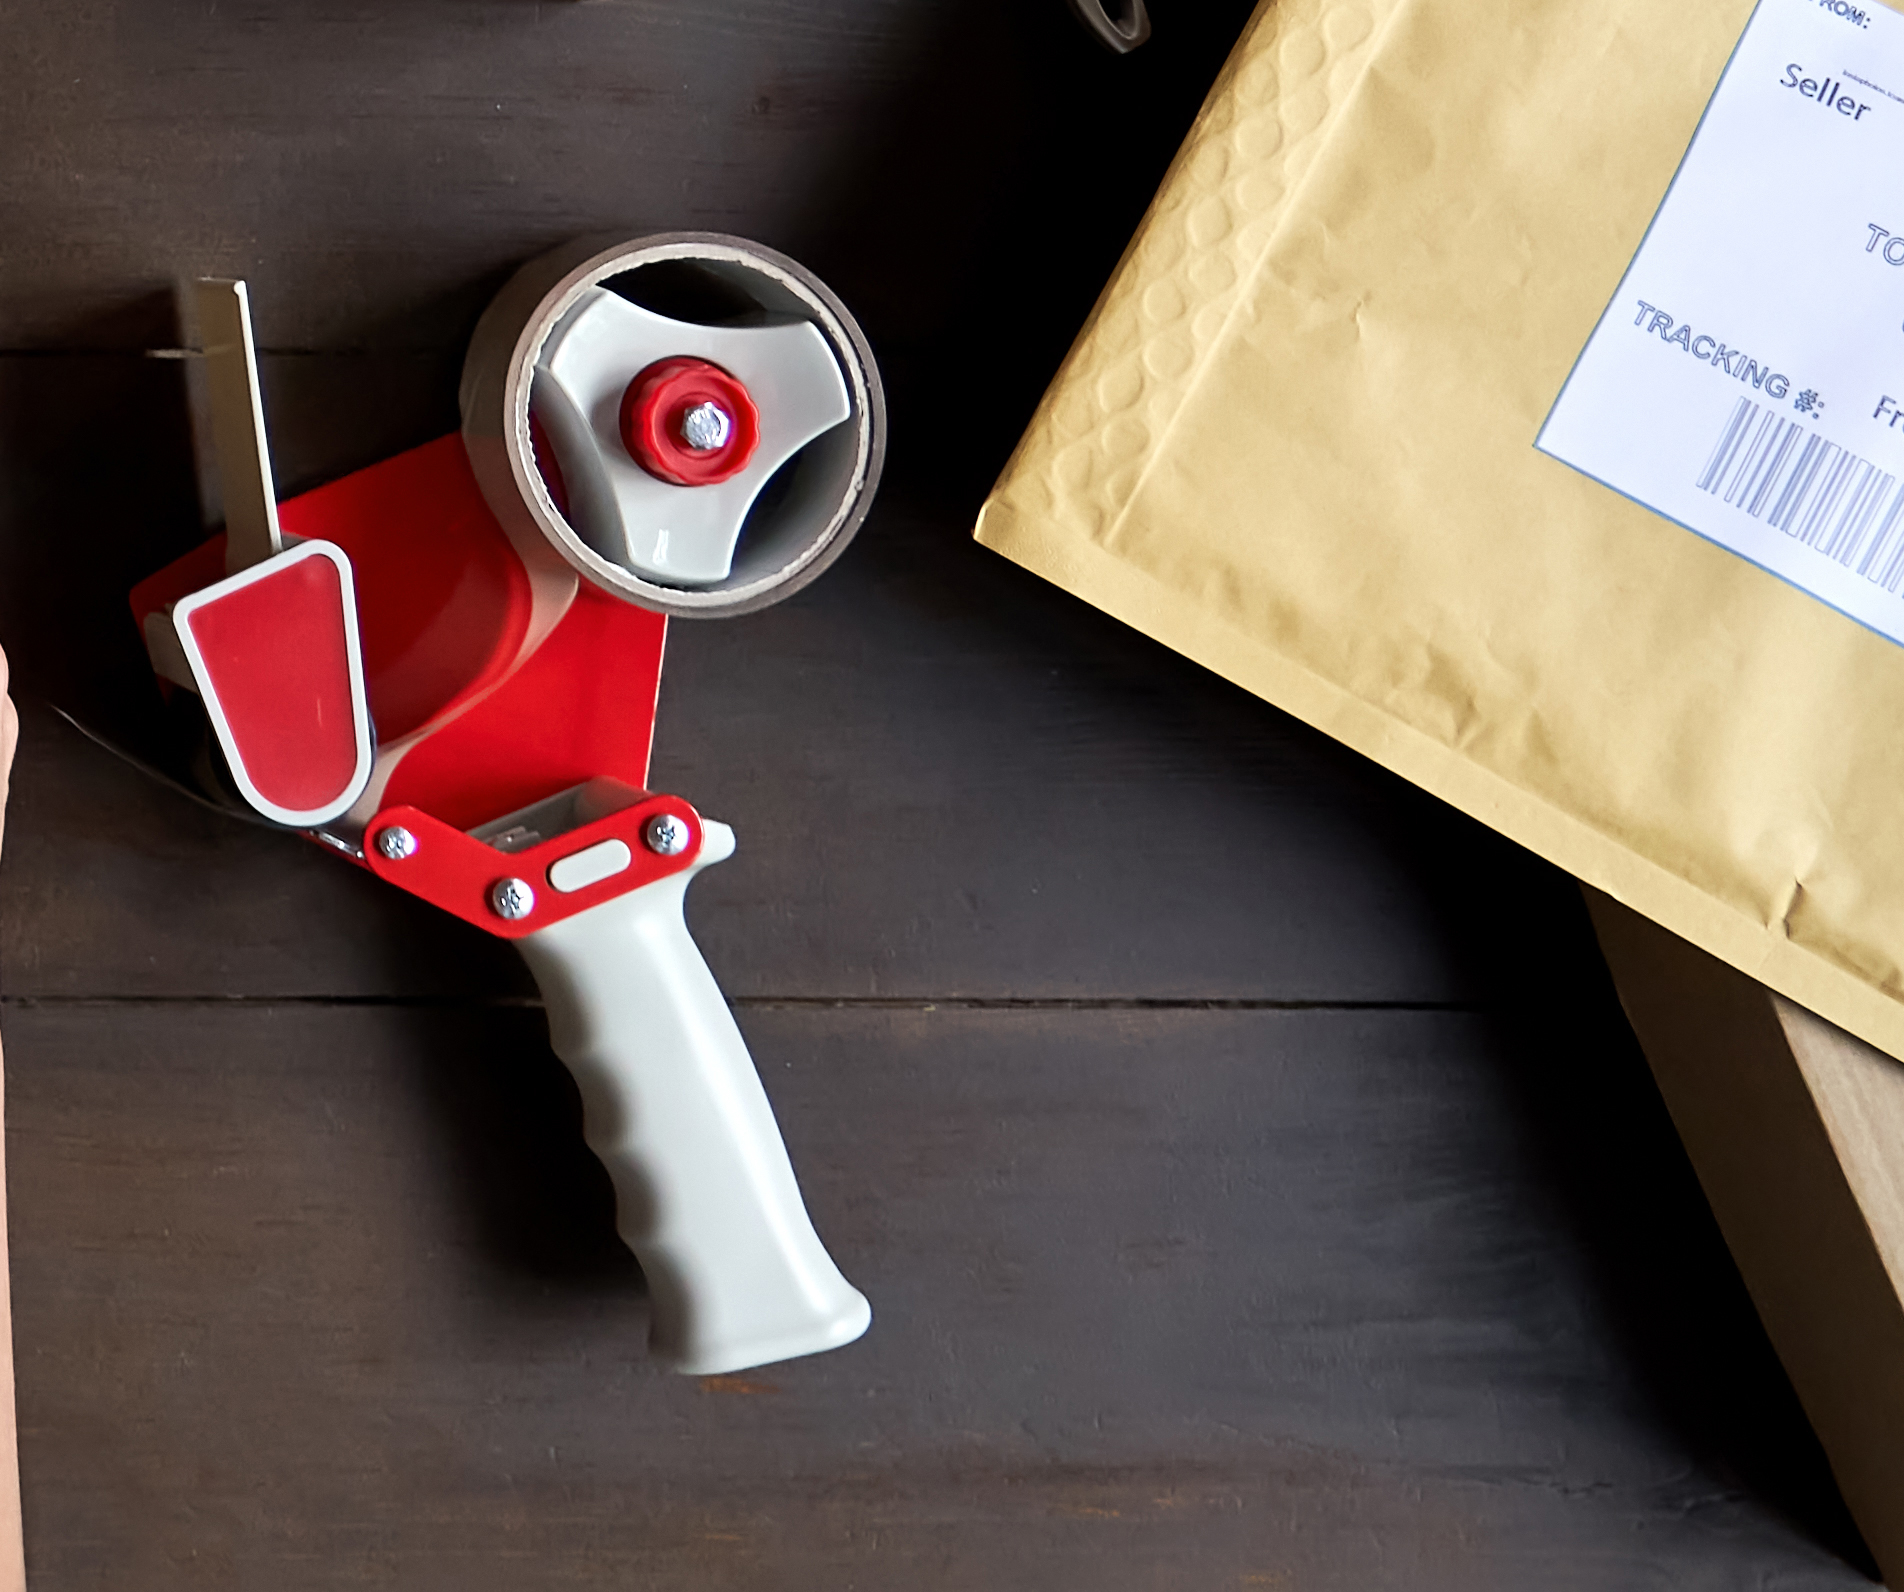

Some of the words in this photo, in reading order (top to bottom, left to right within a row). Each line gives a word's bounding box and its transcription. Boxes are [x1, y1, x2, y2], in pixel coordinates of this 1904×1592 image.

[1779, 63, 1871, 121] Seller
[1634, 300, 1790, 399] TRACKING
[1793, 389, 1825, 421] #:
